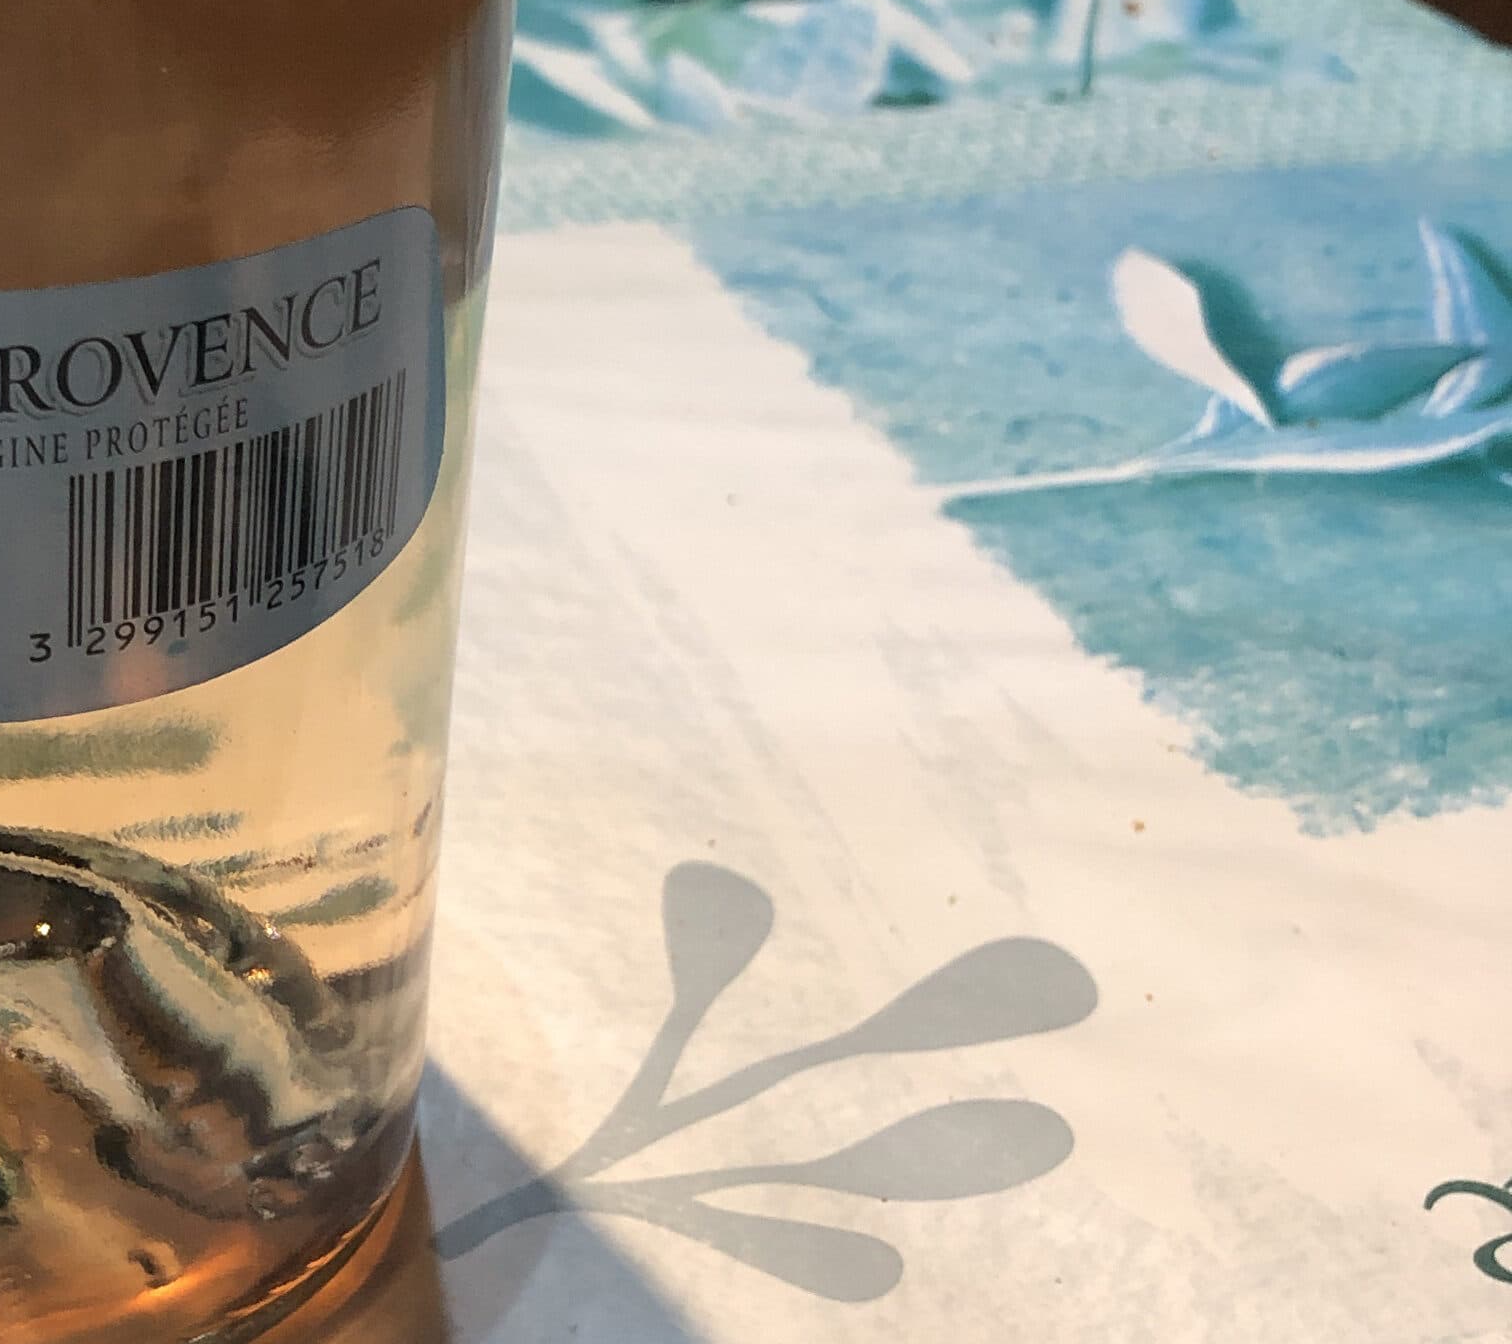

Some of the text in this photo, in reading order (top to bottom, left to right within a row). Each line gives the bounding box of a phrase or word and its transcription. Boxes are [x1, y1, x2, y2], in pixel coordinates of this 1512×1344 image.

[87, 398, 249, 460] PROTÉGÉE
[29, 528, 386, 664] 3 299151 257518
